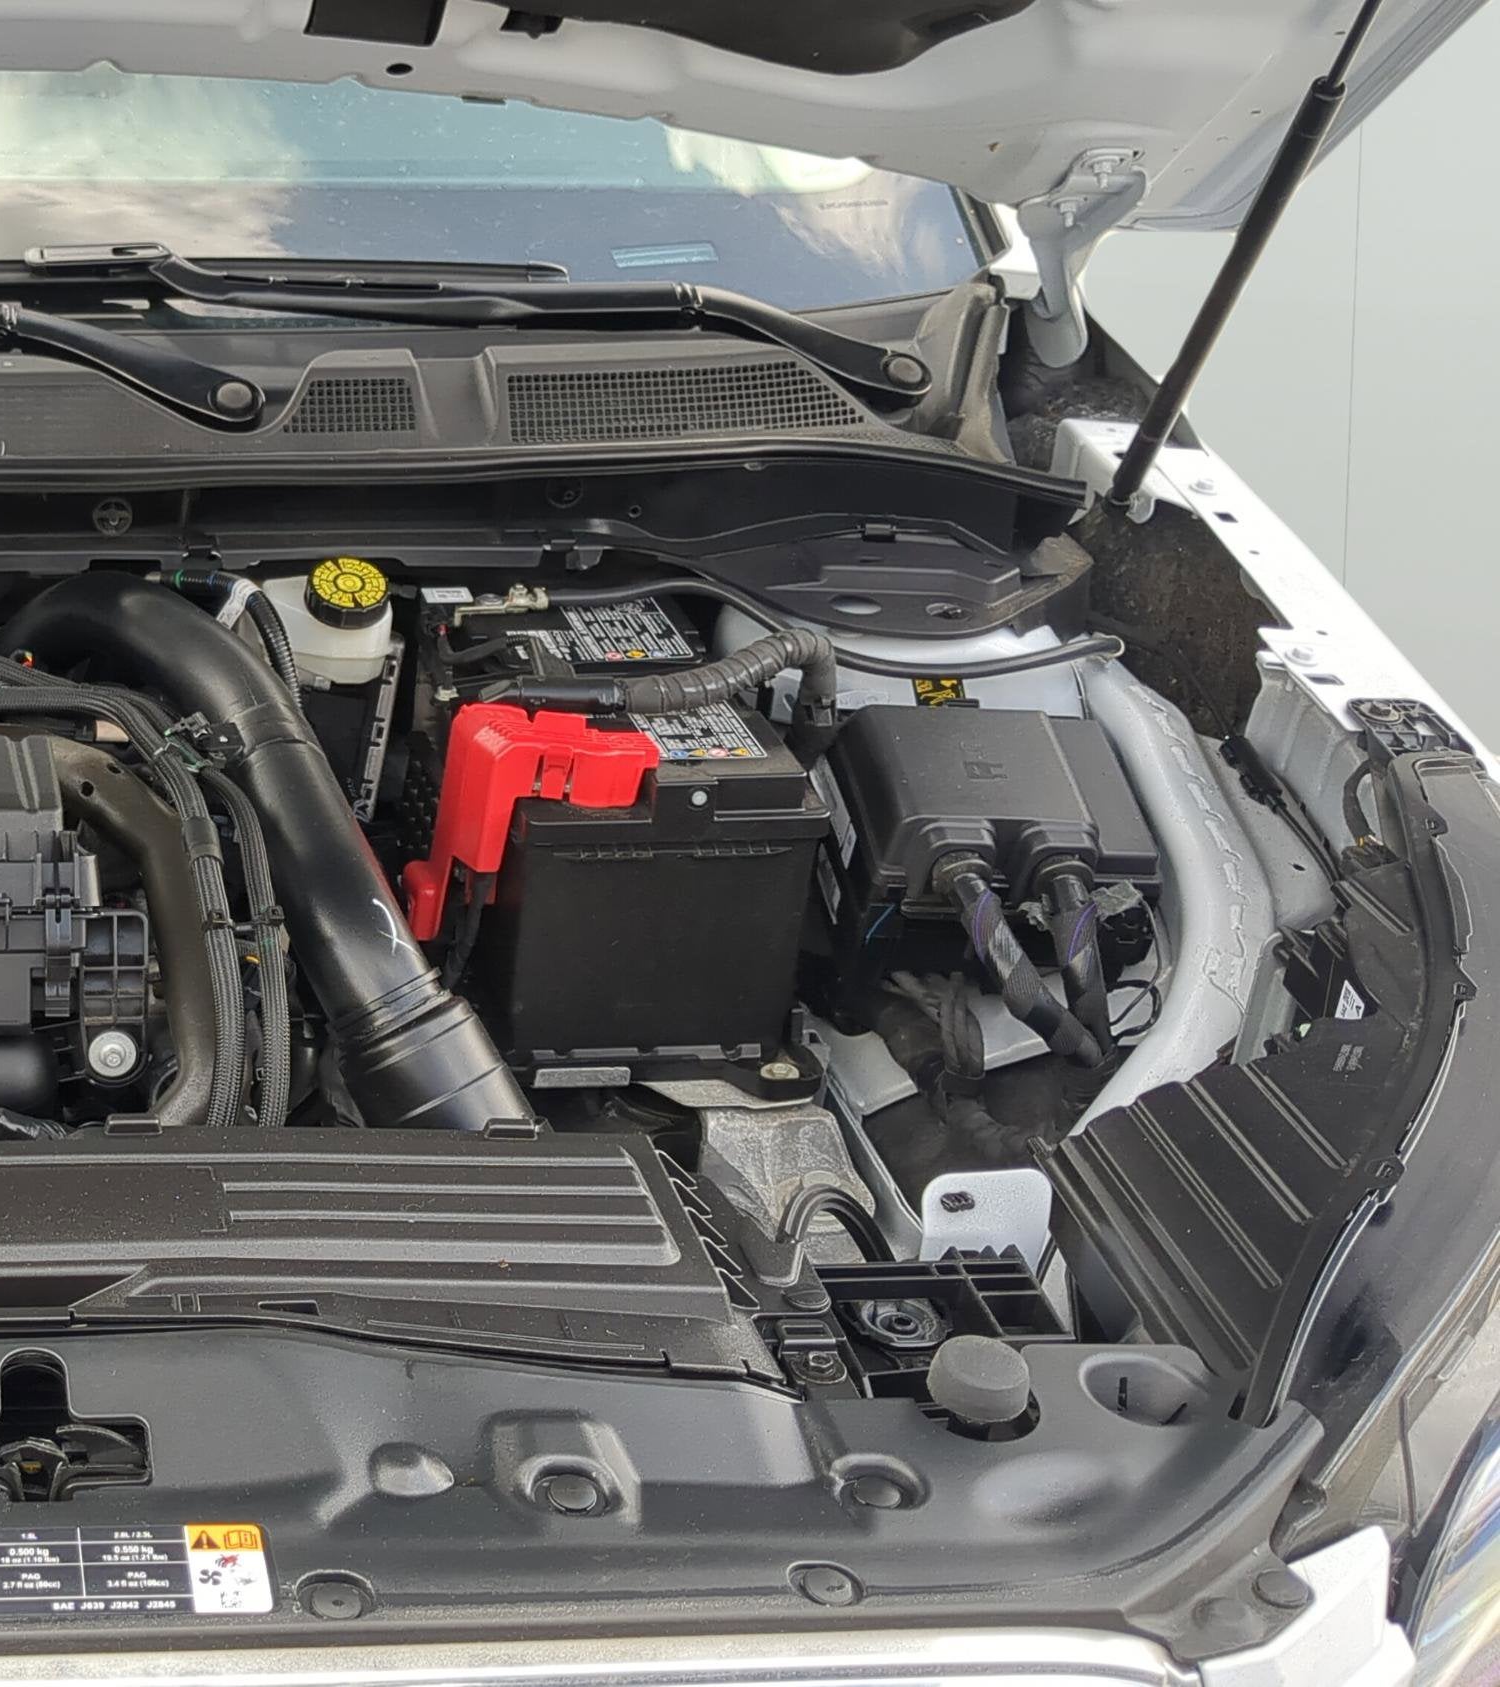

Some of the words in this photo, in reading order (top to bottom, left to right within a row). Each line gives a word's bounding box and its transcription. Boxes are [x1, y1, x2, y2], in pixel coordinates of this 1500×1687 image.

[8, 1548, 35, 1556] 0.500
[36, 1547, 50, 1558] kg
[113, 1546, 139, 1554] 0.550
[141, 1545, 154, 1555] kg
[131, 1553, 150, 1562] (1.21
[21, 1572, 41, 1580] PAG
[127, 1571, 147, 1579] PAG
[52, 1602, 75, 1611] SAE
